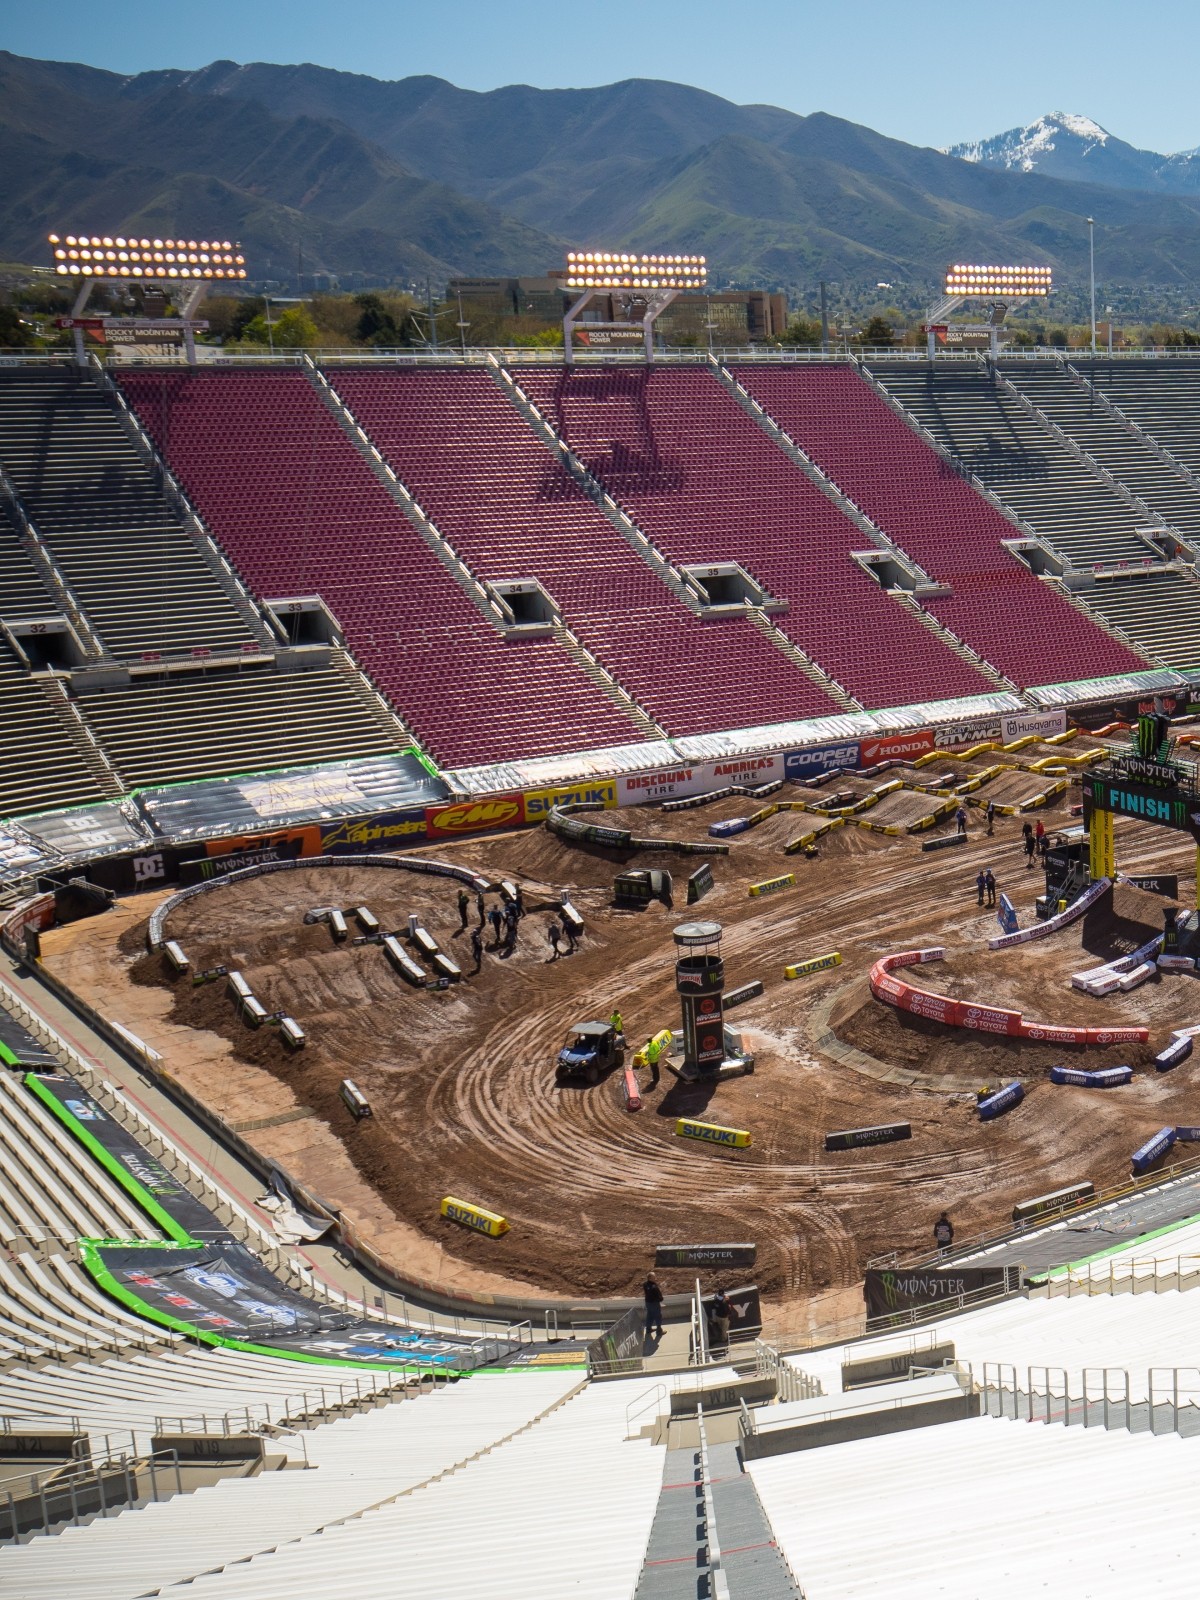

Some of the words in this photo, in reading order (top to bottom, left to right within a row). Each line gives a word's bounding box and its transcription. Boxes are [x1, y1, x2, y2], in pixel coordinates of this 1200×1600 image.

[135, 329, 180, 338] MOUNTAIN
[871, 554, 880, 562] 36
[708, 568, 719, 576] 35
[510, 584, 523, 592] 34
[288, 603, 303, 612] 33
[30, 624, 47, 633] 32
[968, 721, 1001, 732] MOUNTAIN
[1018, 718, 1062, 733] Husqvarna
[879, 740, 931, 756] HONDA
[787, 746, 859, 767] COOPER
[822, 756, 857, 769] TIRES
[713, 758, 775, 776] AMERICA'S
[1119, 757, 1178, 782] MONSTER
[626, 769, 693, 790] DISCOUNT
[731, 771, 758, 782] TIRE
[1127, 774, 1169, 788] ENERGY
[645, 784, 675, 796] TIRE
[527, 787, 614, 813] SUZUKI
[1110, 789, 1170, 820] FINISH
[433, 802, 518, 828] FMF
[352, 820, 428, 844] alpinestars
[133, 853, 166, 882] DC
[215, 851, 281, 871] MONSTER
[758, 876, 792, 894] SUZUKI
[794, 956, 837, 976] SUZUKI
[924, 997, 946, 1008] TOYOTA
[921, 1006, 945, 1019] TOYOTA
[982, 1010, 1009, 1021] TOYOTA
[979, 1019, 1008, 1032] TOYOTA
[1046, 1030, 1076, 1040] TOYOTA
[1114, 1032, 1141, 1041] TOYOTA
[683, 1124, 737, 1144] SUZUKI
[855, 1128, 895, 1140] MONSTER
[1046, 1191, 1081, 1208] MONSTER
[446, 1204, 492, 1233] SUZUKI
[688, 1250, 733, 1261] MONSTER
[896, 1277, 966, 1298] MONSTER
